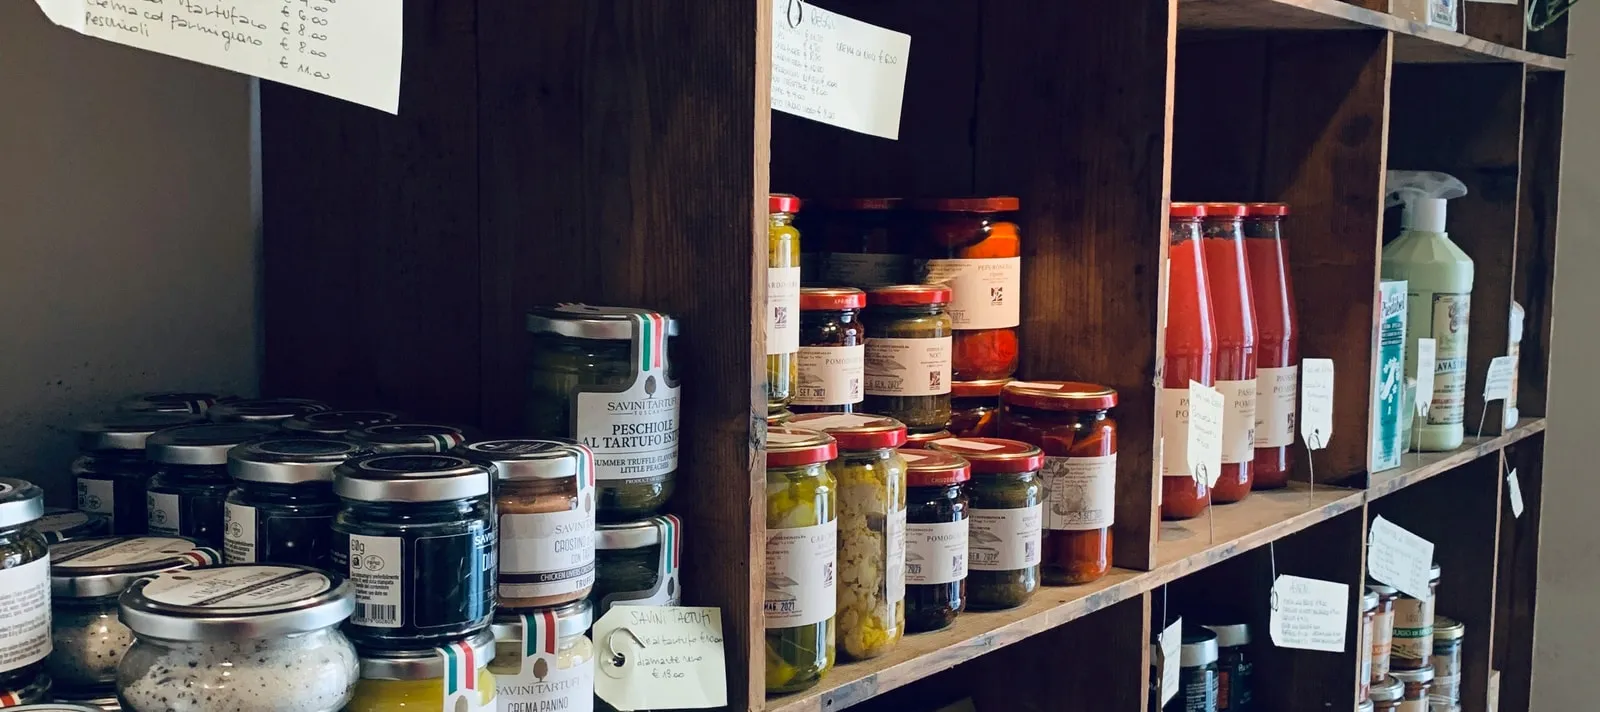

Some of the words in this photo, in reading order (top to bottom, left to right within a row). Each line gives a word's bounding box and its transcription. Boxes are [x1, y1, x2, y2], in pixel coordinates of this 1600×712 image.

[298, 23, 328, 41] 8.00
[612, 419, 673, 436] PESCHIOLE
[603, 434, 662, 448] TARTUFO
[631, 611, 666, 626] SAVINI
[541, 696, 569, 712] PANINO
